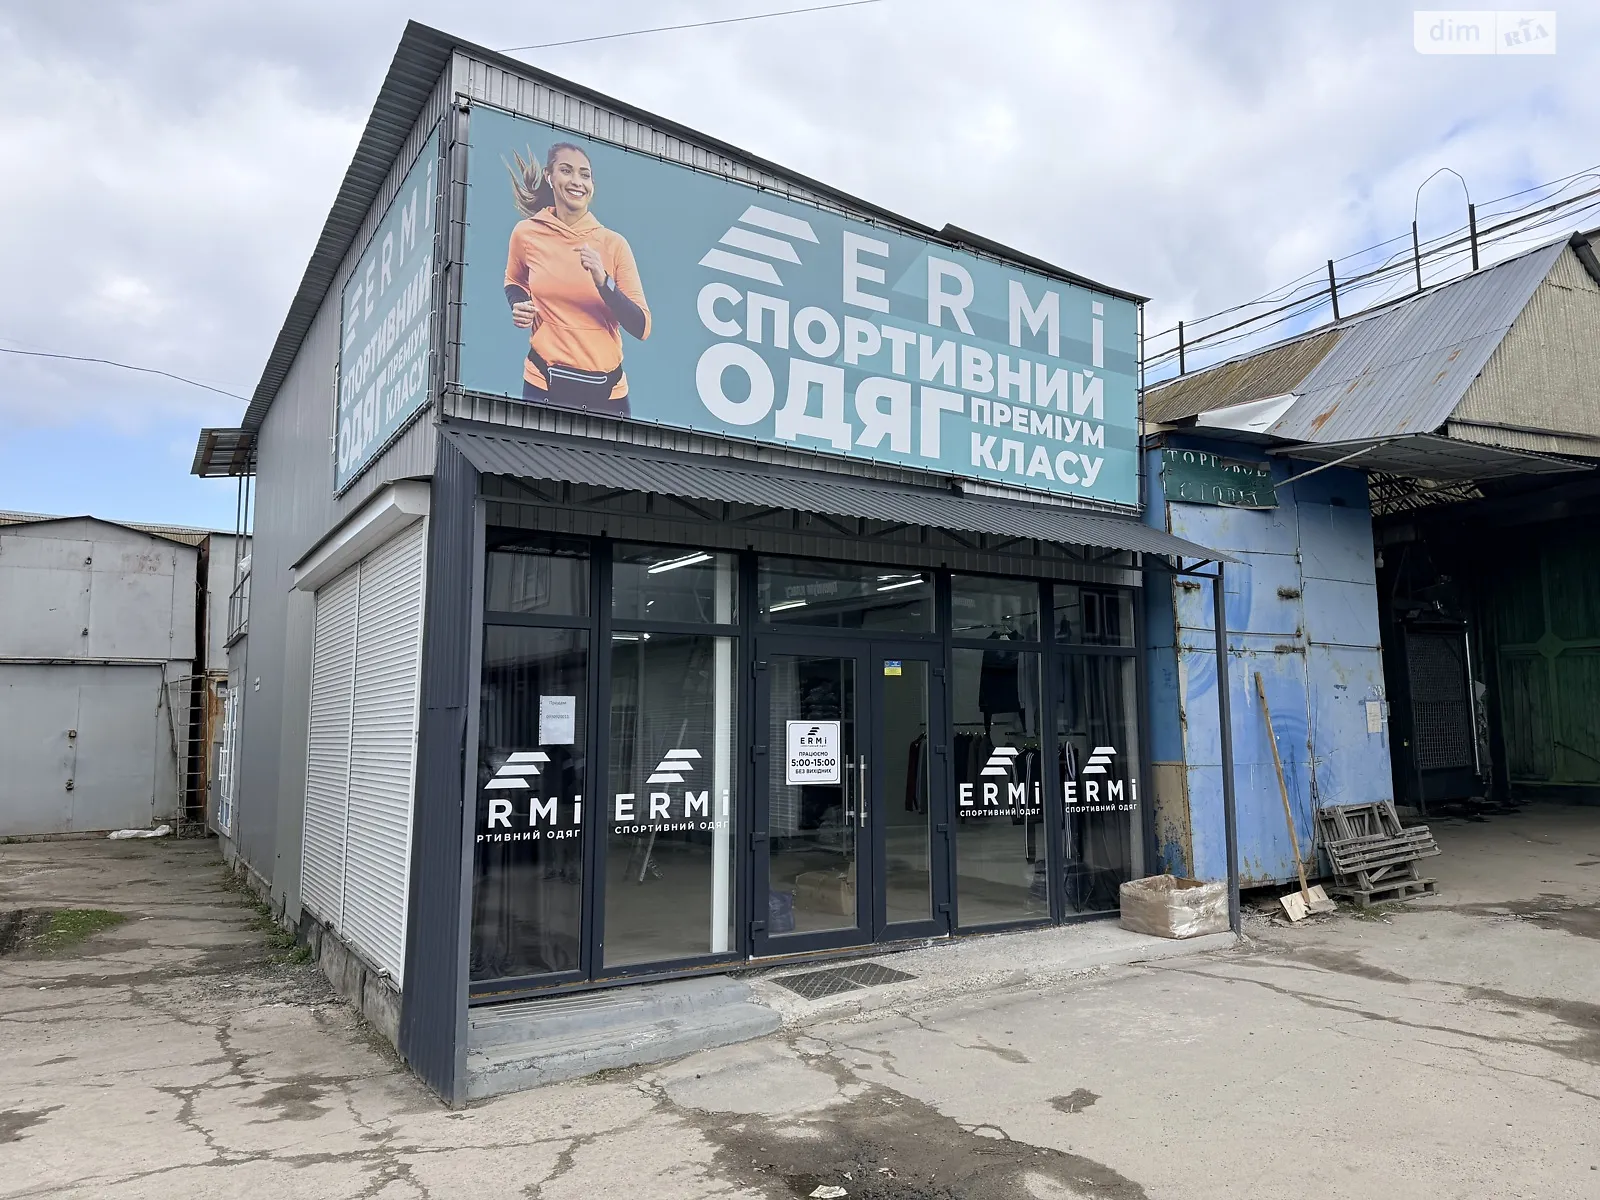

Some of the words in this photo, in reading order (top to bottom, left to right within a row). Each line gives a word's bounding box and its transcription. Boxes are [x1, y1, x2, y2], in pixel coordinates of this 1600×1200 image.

[843, 231, 1104, 368] ERMi
[341, 254, 432, 412] СПОРТИВНИЙ
[386, 313, 429, 385] ПРЕМІУМ
[696, 282, 1104, 420] СПОРТИВНИЙ
[385, 349, 427, 425] КЛАСУ
[695, 342, 964, 460] ОДЯГ
[338, 370, 387, 474] ОДЯГ
[970, 396, 1105, 449] ПРЕМІУМ
[970, 432, 1104, 487] КЛАСУ
[791, 758, 836, 767] 5:00-15:00
[546, 829, 581, 840] ОДЯГ
[614, 821, 695, 834] СПОРТИВНИЙ
[699, 820, 729, 830] ОДЯГ
[960, 808, 1016, 817] СПОРТИВНИЙ
[1019, 808, 1041, 816] ОДЯГ
[1065, 803, 1116, 813] СПОРТИВНИЙ
